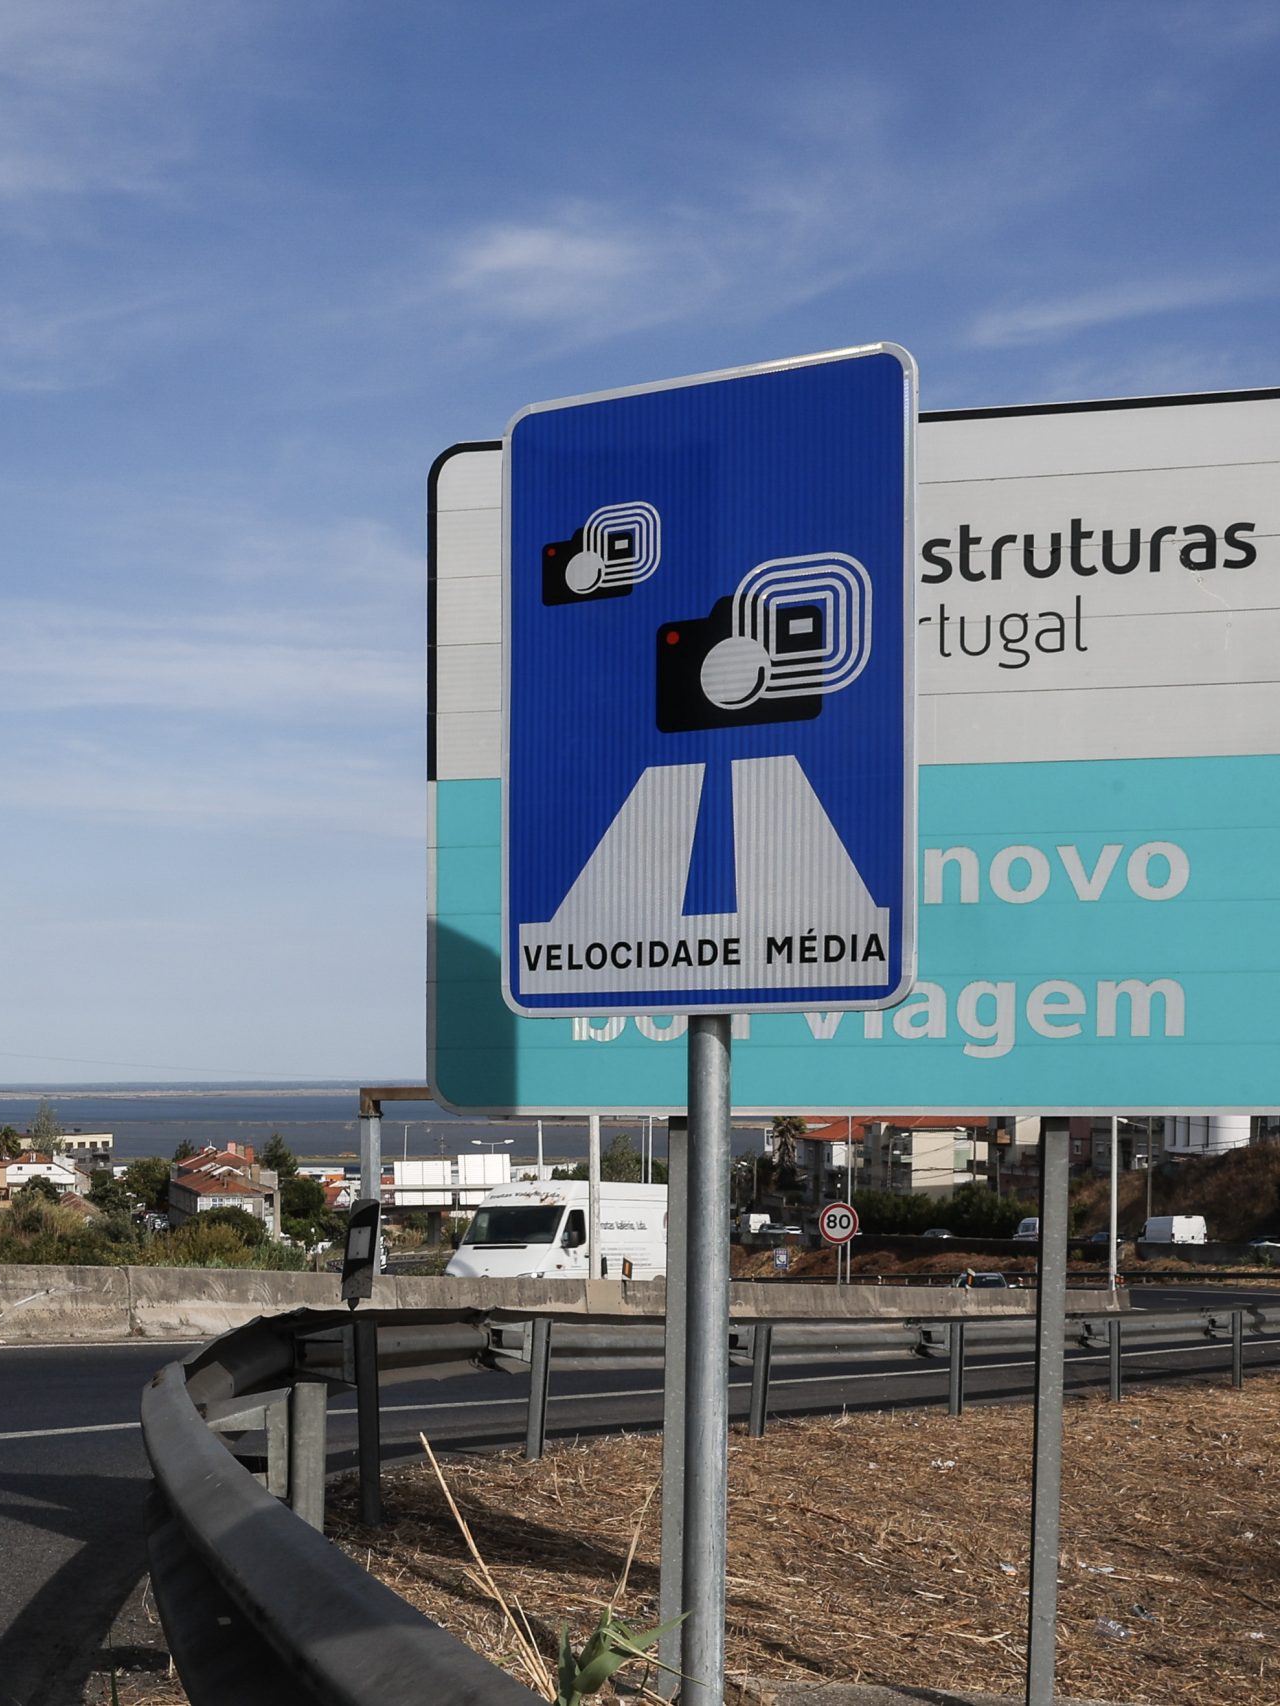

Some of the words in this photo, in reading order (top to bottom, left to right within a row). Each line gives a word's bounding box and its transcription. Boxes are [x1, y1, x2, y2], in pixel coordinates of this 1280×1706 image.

[921, 517, 1257, 584] struturas
[923, 840, 1190, 904] novo
[524, 937, 741, 971] VELOCIDADE
[766, 928, 886, 965] MÉDIA
[826, 1214, 851, 1229] 80
